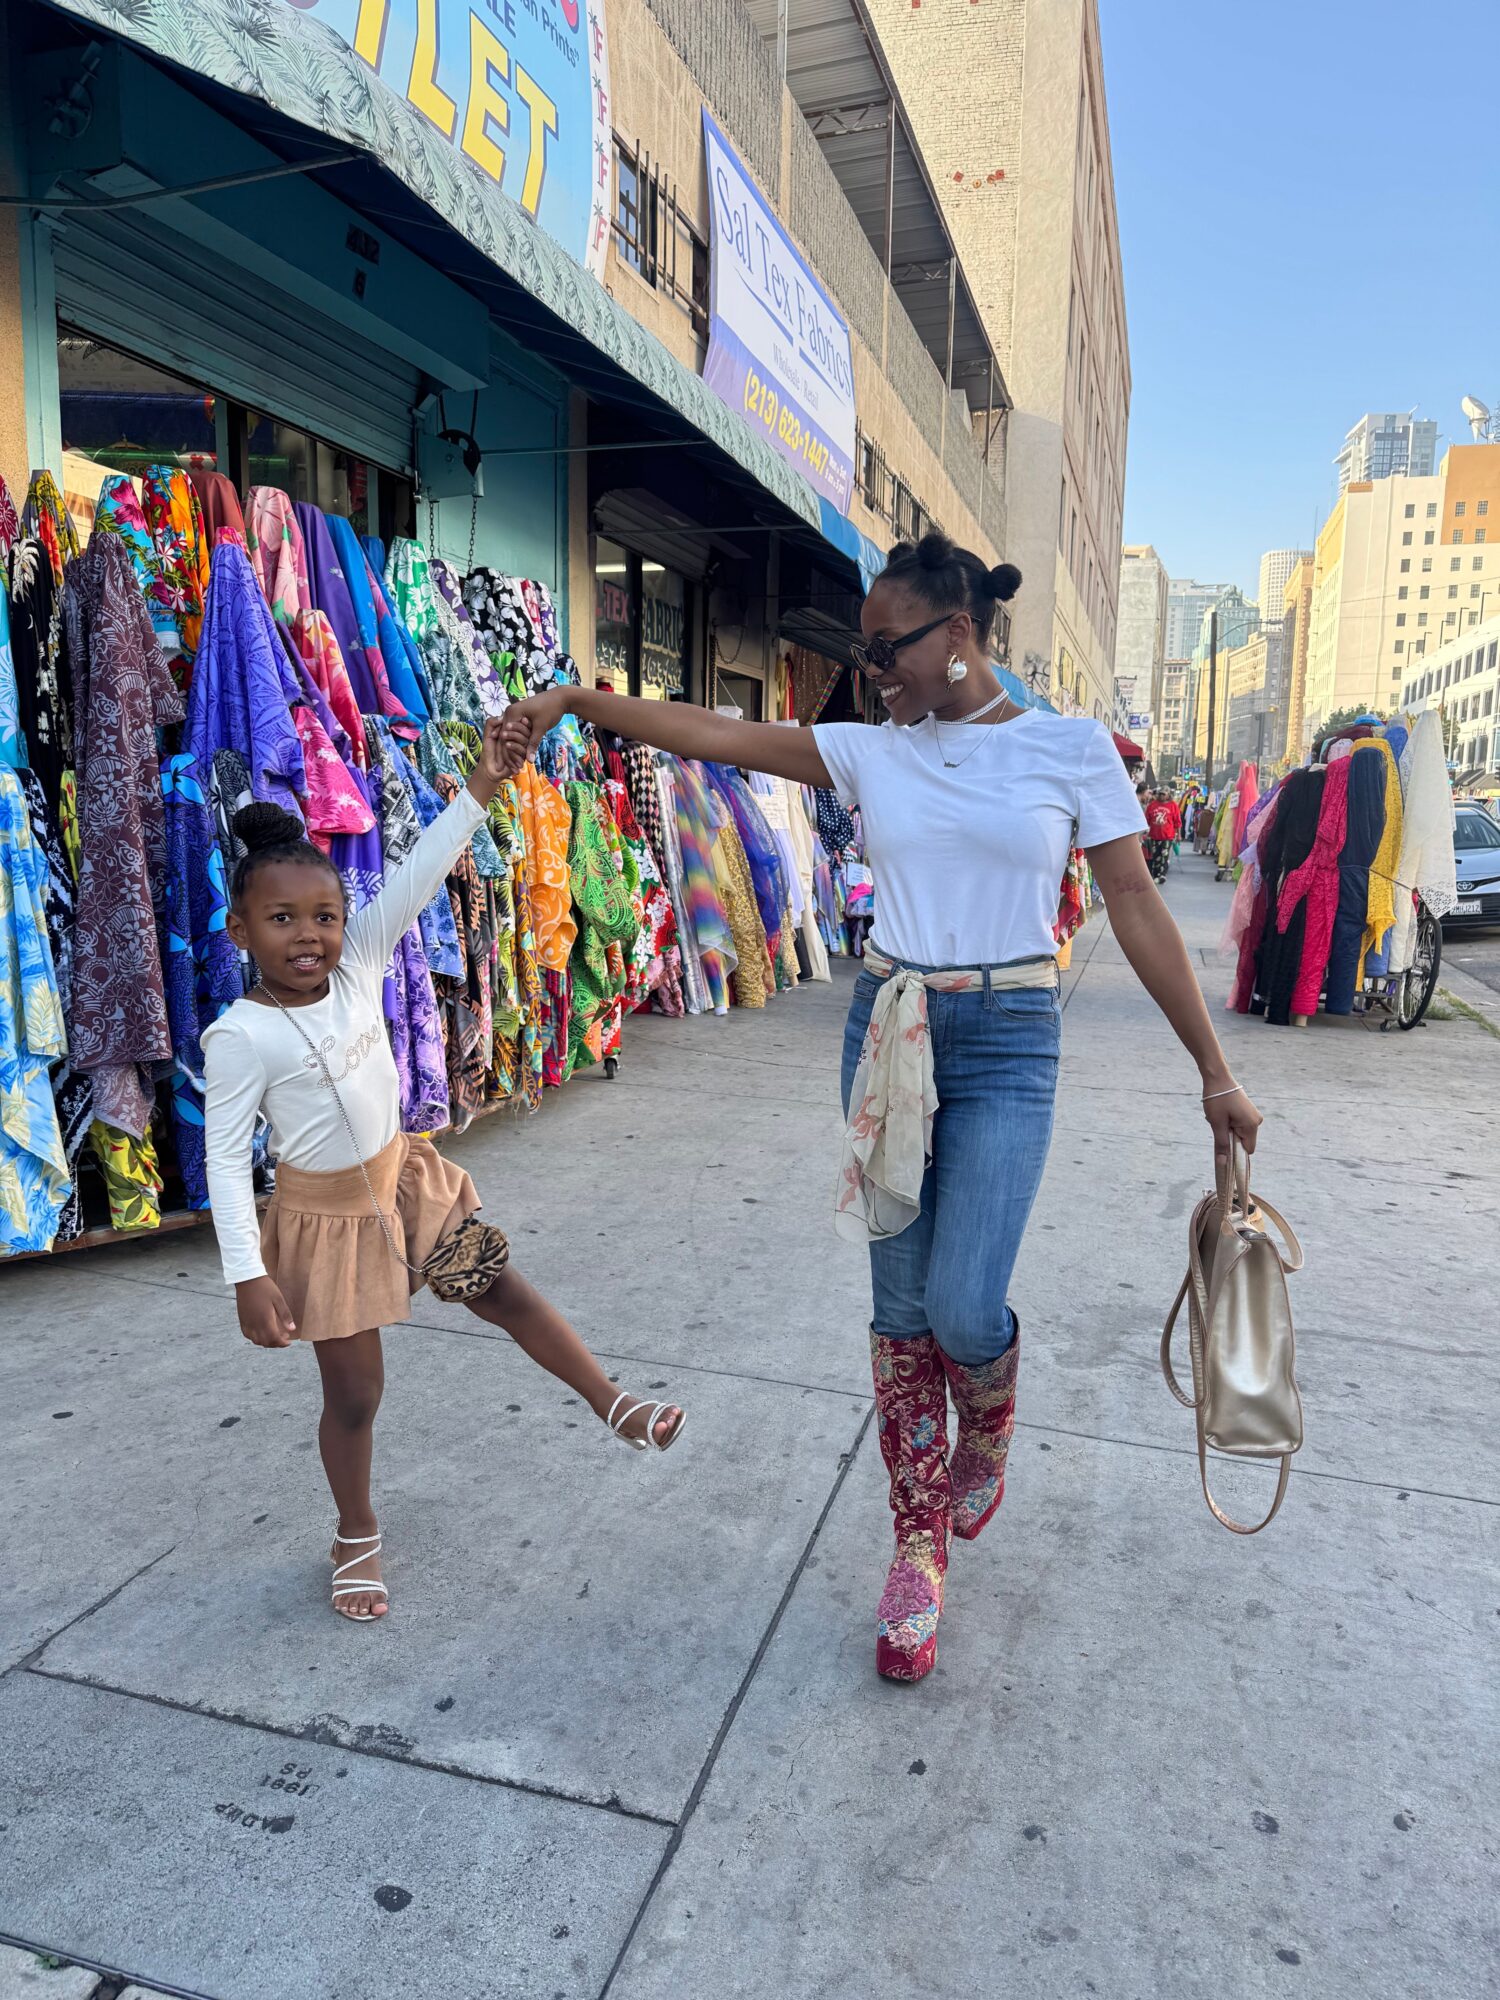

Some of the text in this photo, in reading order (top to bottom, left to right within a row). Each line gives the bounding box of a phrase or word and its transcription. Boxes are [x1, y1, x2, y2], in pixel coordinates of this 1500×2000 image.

[487, 0, 516, 38] LE
[520, 0, 538, 22] an
[717, 166, 851, 398] Sal Tex Fabrics
[744, 367, 829, 476] (213) 623-1447
[604, 581, 629, 626] TEX
[303, 1020, 381, 1088] Love
